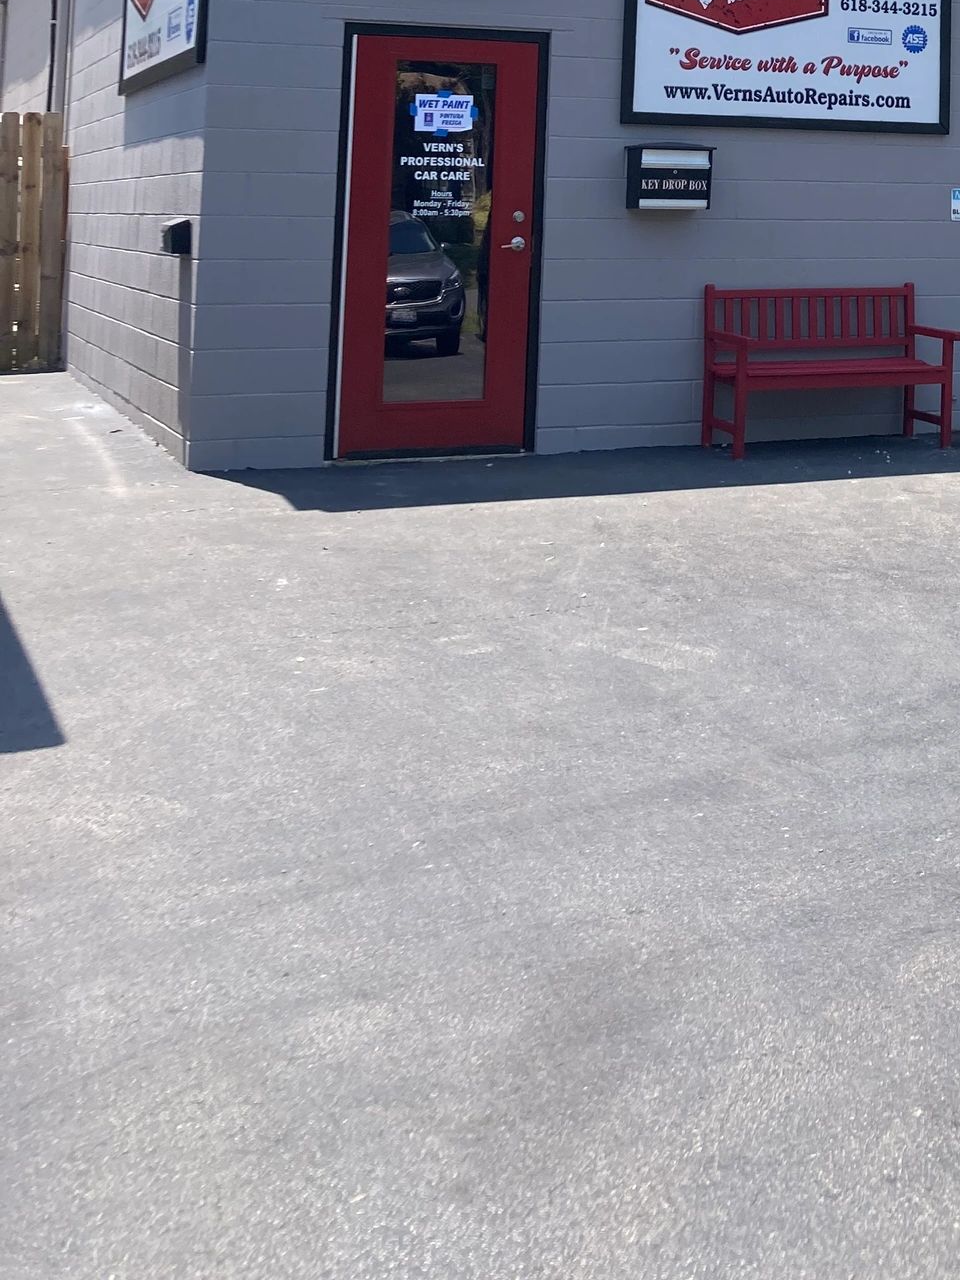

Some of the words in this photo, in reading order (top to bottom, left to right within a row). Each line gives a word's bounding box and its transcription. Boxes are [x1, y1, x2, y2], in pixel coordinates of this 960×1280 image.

[861, 34, 890, 44] facebook
[905, 33, 925, 44] ASE
[757, 54, 798, 75] with
[802, 61, 817, 76] a
[663, 83, 911, 110] www.VernsAutoRepairs.com
[419, 99, 440, 109] WET
[442, 99, 470, 110] PAINT
[423, 143, 464, 152] VERN'S
[400, 156, 485, 167] PROFESSIONAL
[414, 171, 438, 181] CAR
[440, 172, 471, 181] CARE
[641, 179, 660, 190] KEY
[662, 179, 687, 190] DROP
[689, 180, 708, 191] BOX
[413, 200, 441, 209] Monday
[447, 201, 470, 209] Friday
